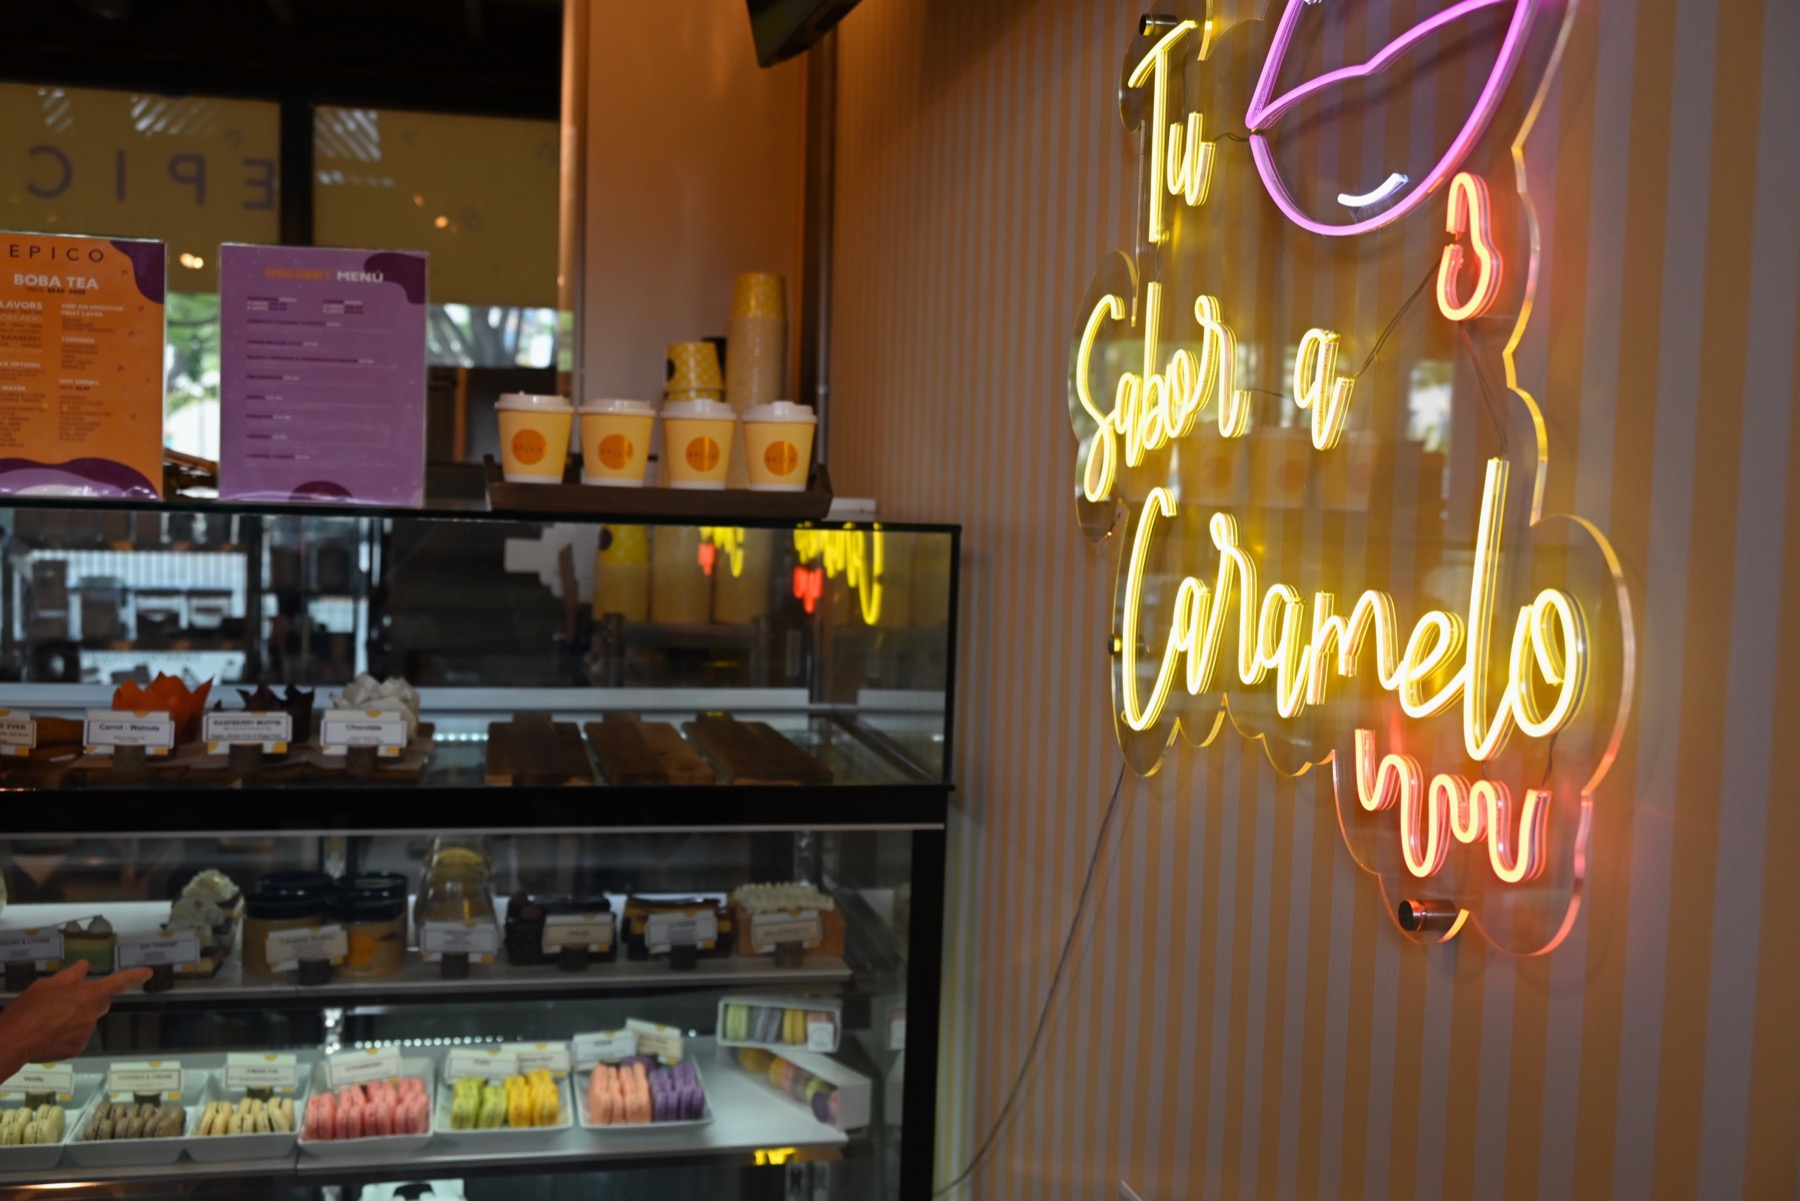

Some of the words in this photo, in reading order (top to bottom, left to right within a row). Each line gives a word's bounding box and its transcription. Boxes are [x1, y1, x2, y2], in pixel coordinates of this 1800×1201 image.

[1127, 19, 1217, 243] Tu
[9, 244, 104, 263] EPICO
[14, 273, 62, 288] BOBA
[66, 276, 99, 291] TEA
[1076, 281, 1251, 502] Sabor
[1122, 457, 1589, 761] Caramelo
[99, 723, 124, 732] Carrot
[130, 724, 161, 732] Walnuts
